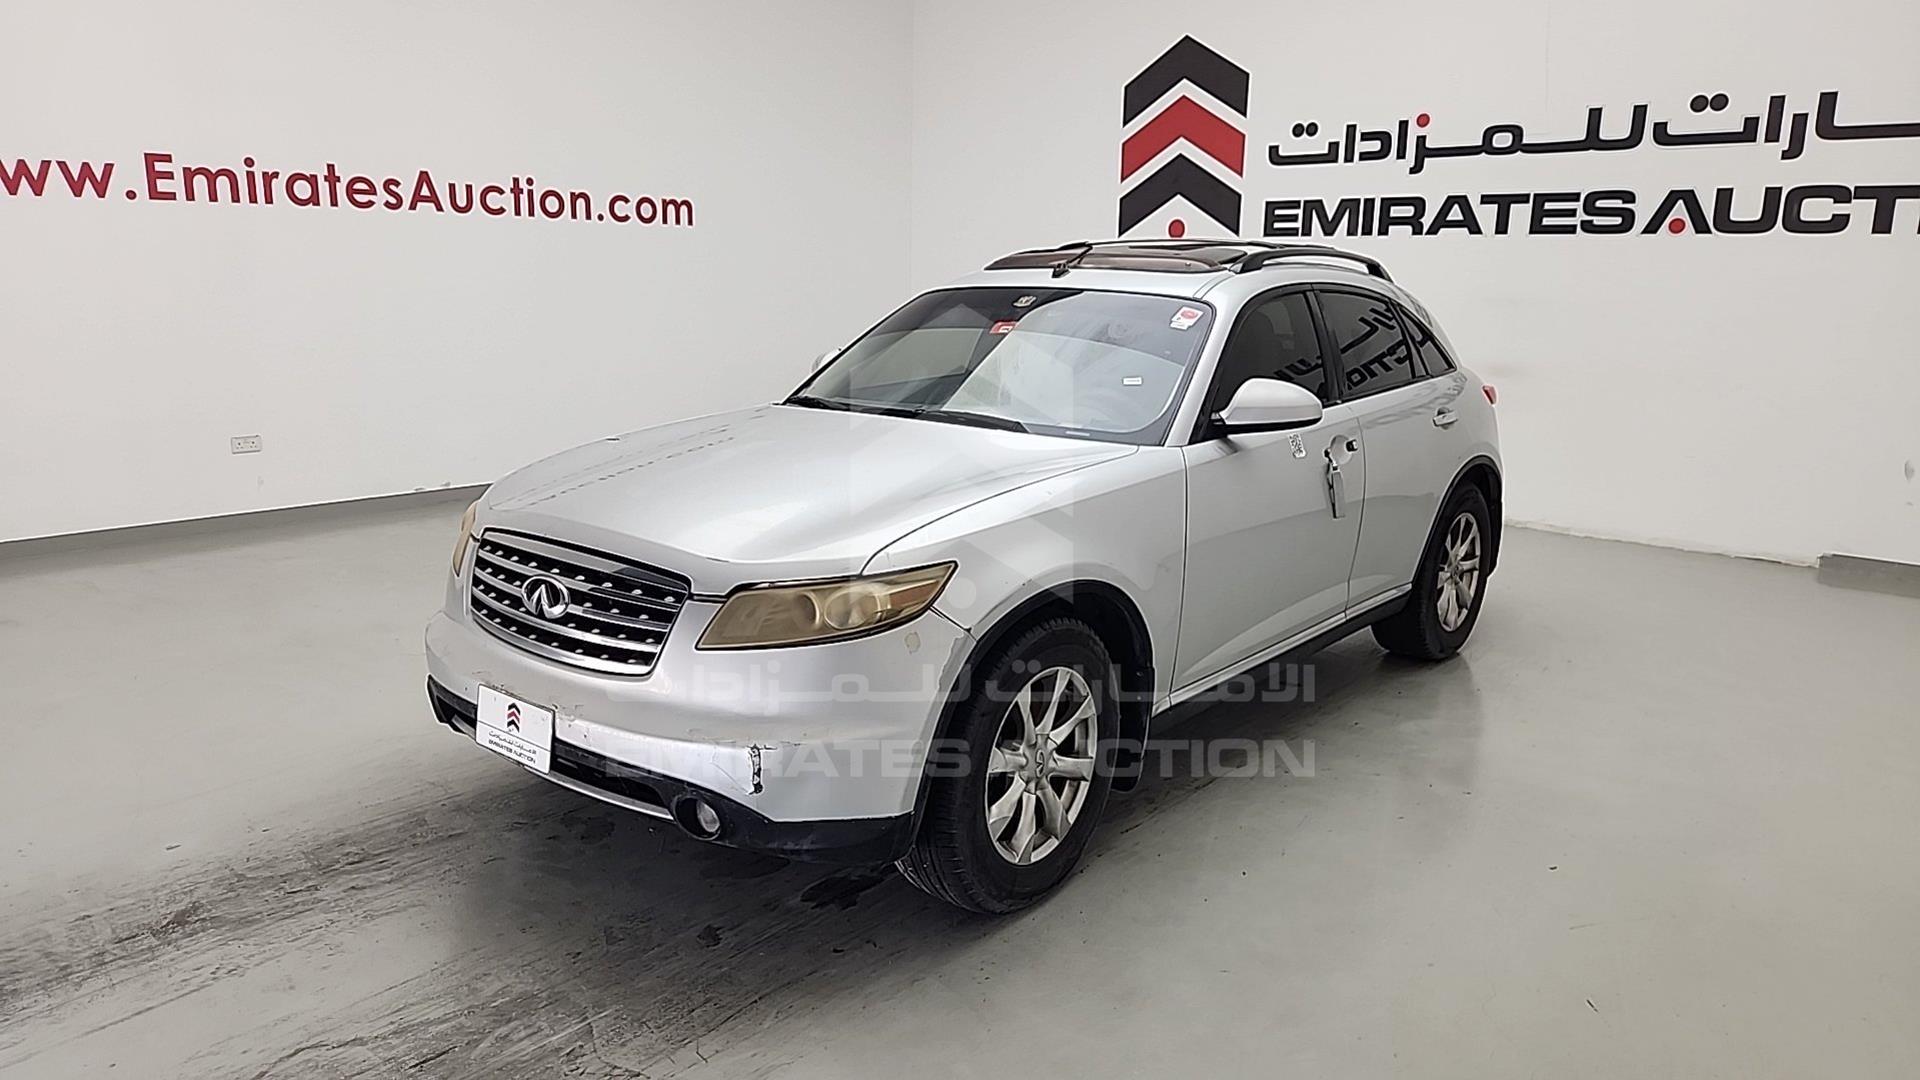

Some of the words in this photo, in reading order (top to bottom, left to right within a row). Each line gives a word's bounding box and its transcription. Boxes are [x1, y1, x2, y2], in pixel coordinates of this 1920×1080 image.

[1268, 103, 1649, 174] للمزادات
[1263, 189, 1637, 237] EMIRATES
[1640, 184, 1920, 235] AUCT
